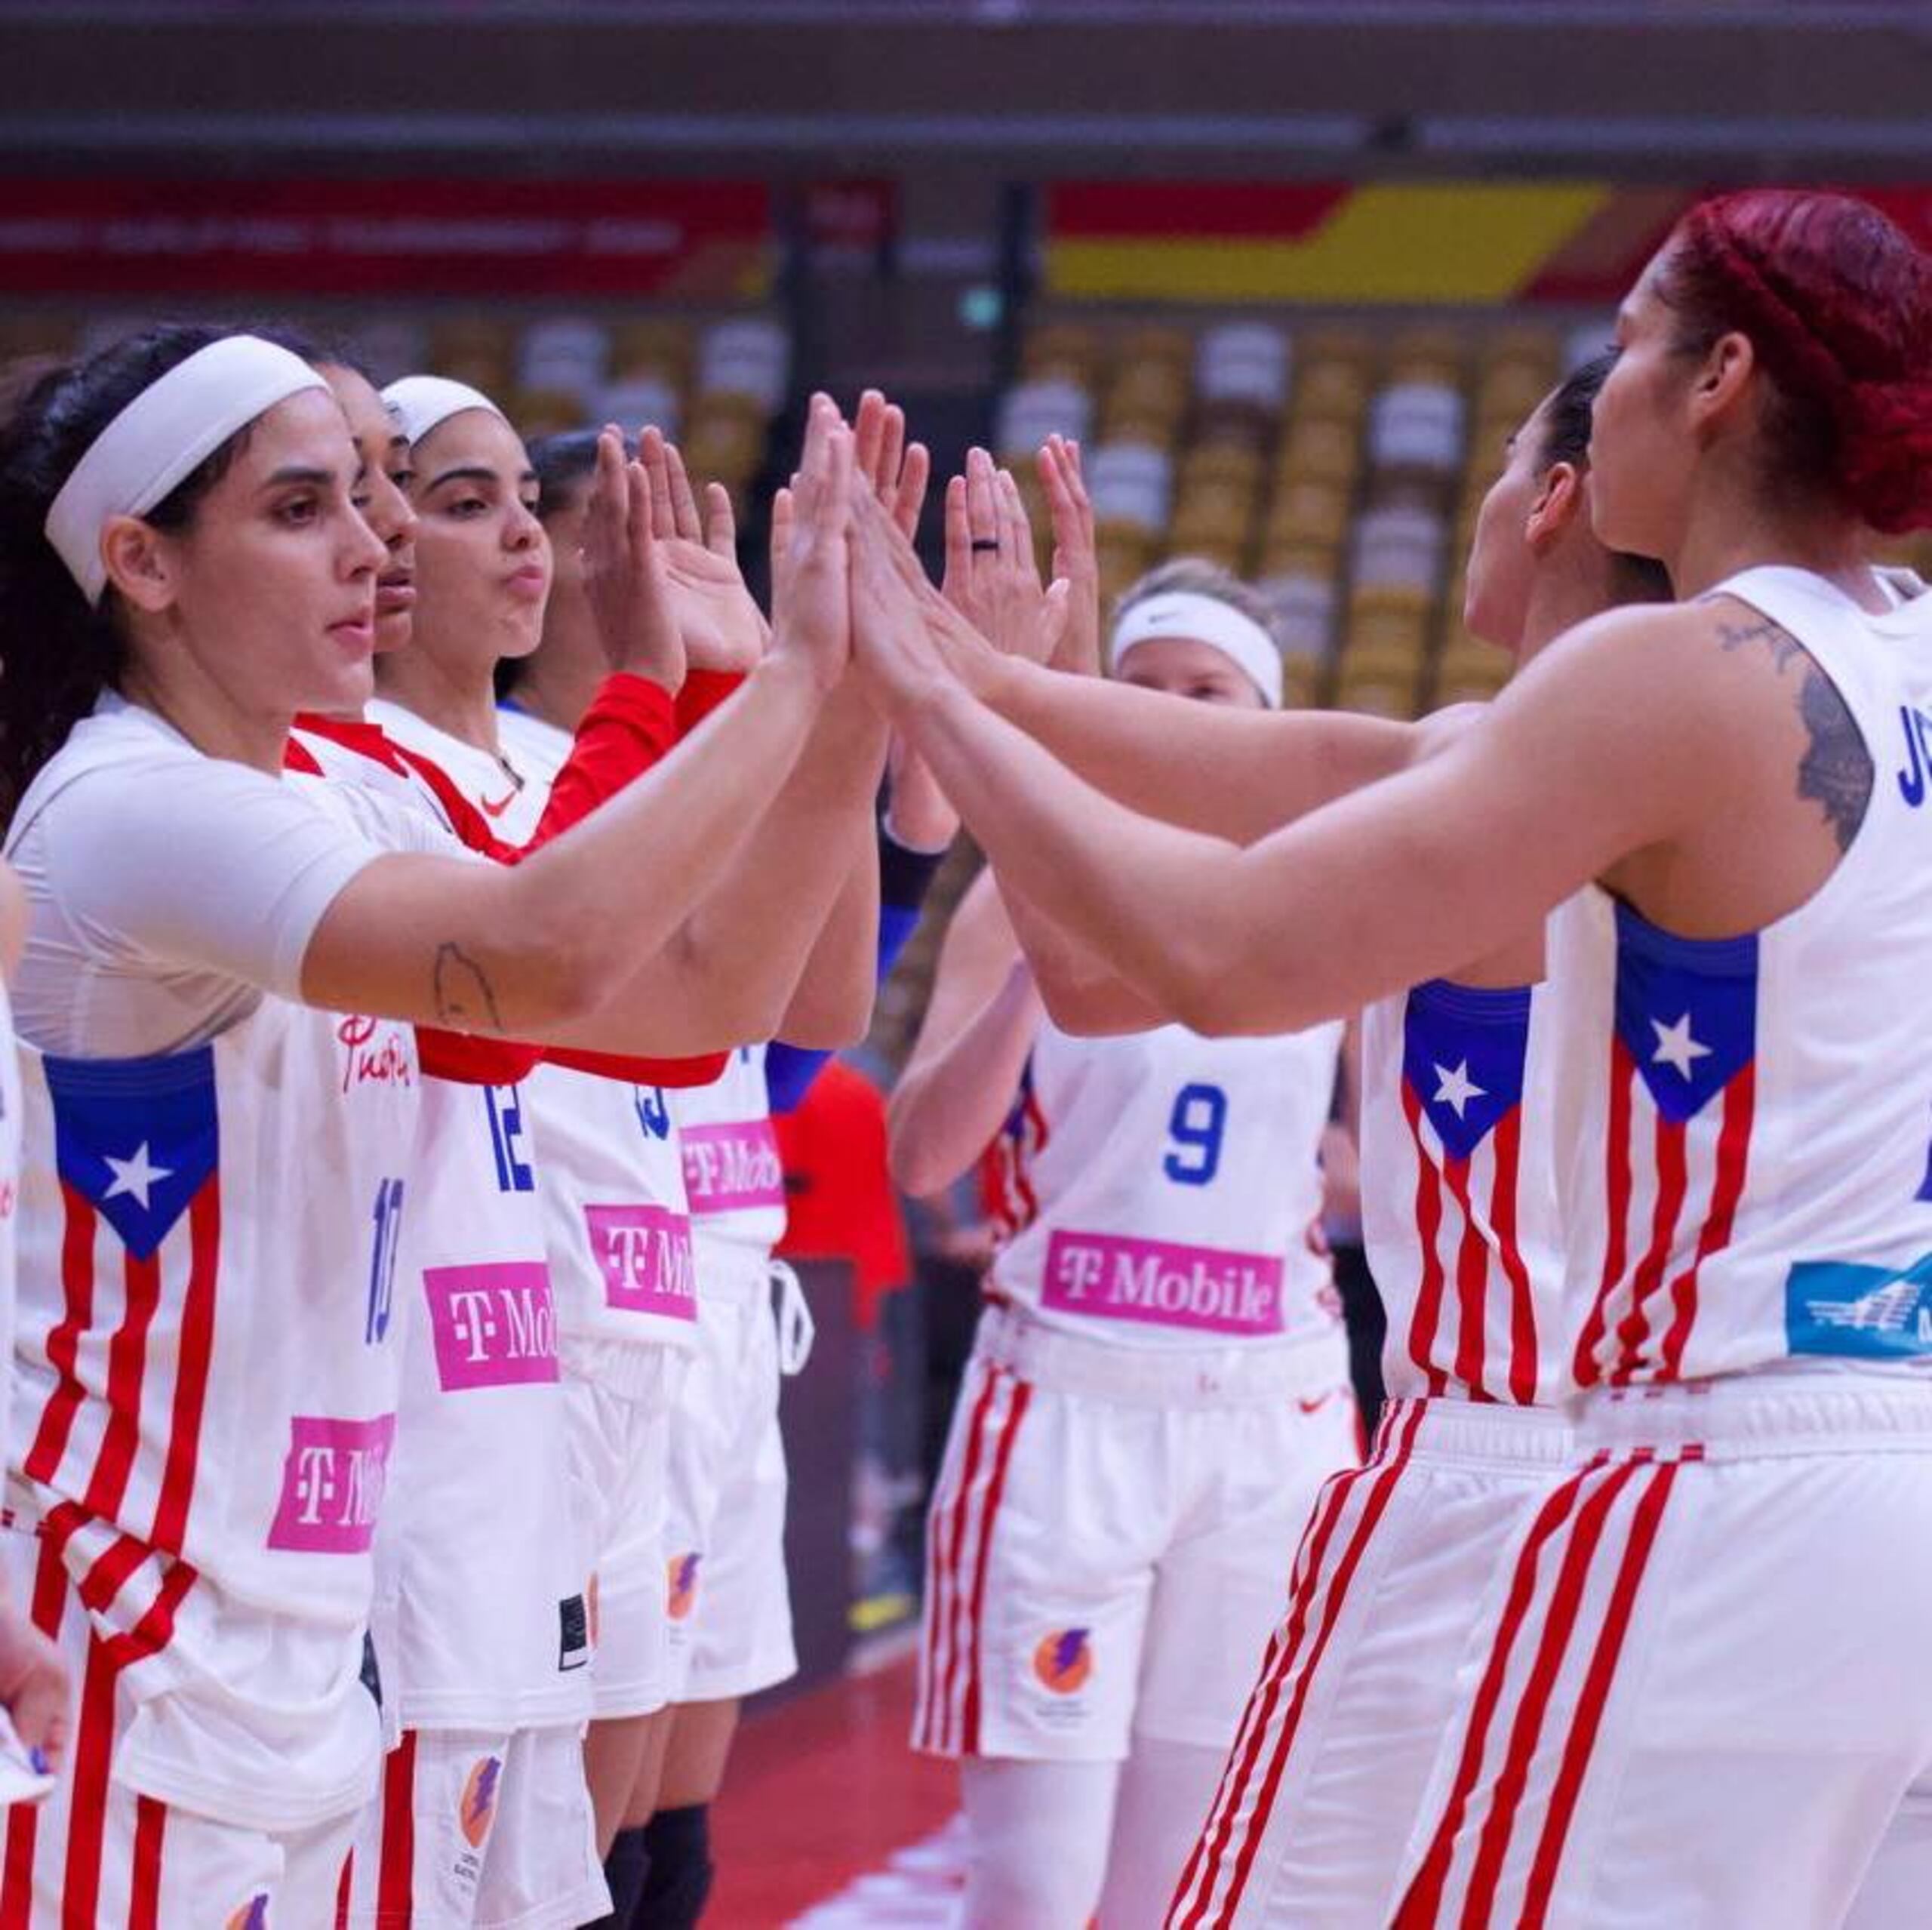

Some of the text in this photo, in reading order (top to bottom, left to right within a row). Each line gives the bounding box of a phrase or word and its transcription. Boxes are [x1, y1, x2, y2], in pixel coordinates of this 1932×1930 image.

[1163, 1082, 1227, 1186] 9
[606, 1228, 648, 1289] T
[1058, 1247, 1273, 1322] T Mobile
[449, 1291, 497, 1362] T
[297, 1448, 334, 1524] T
